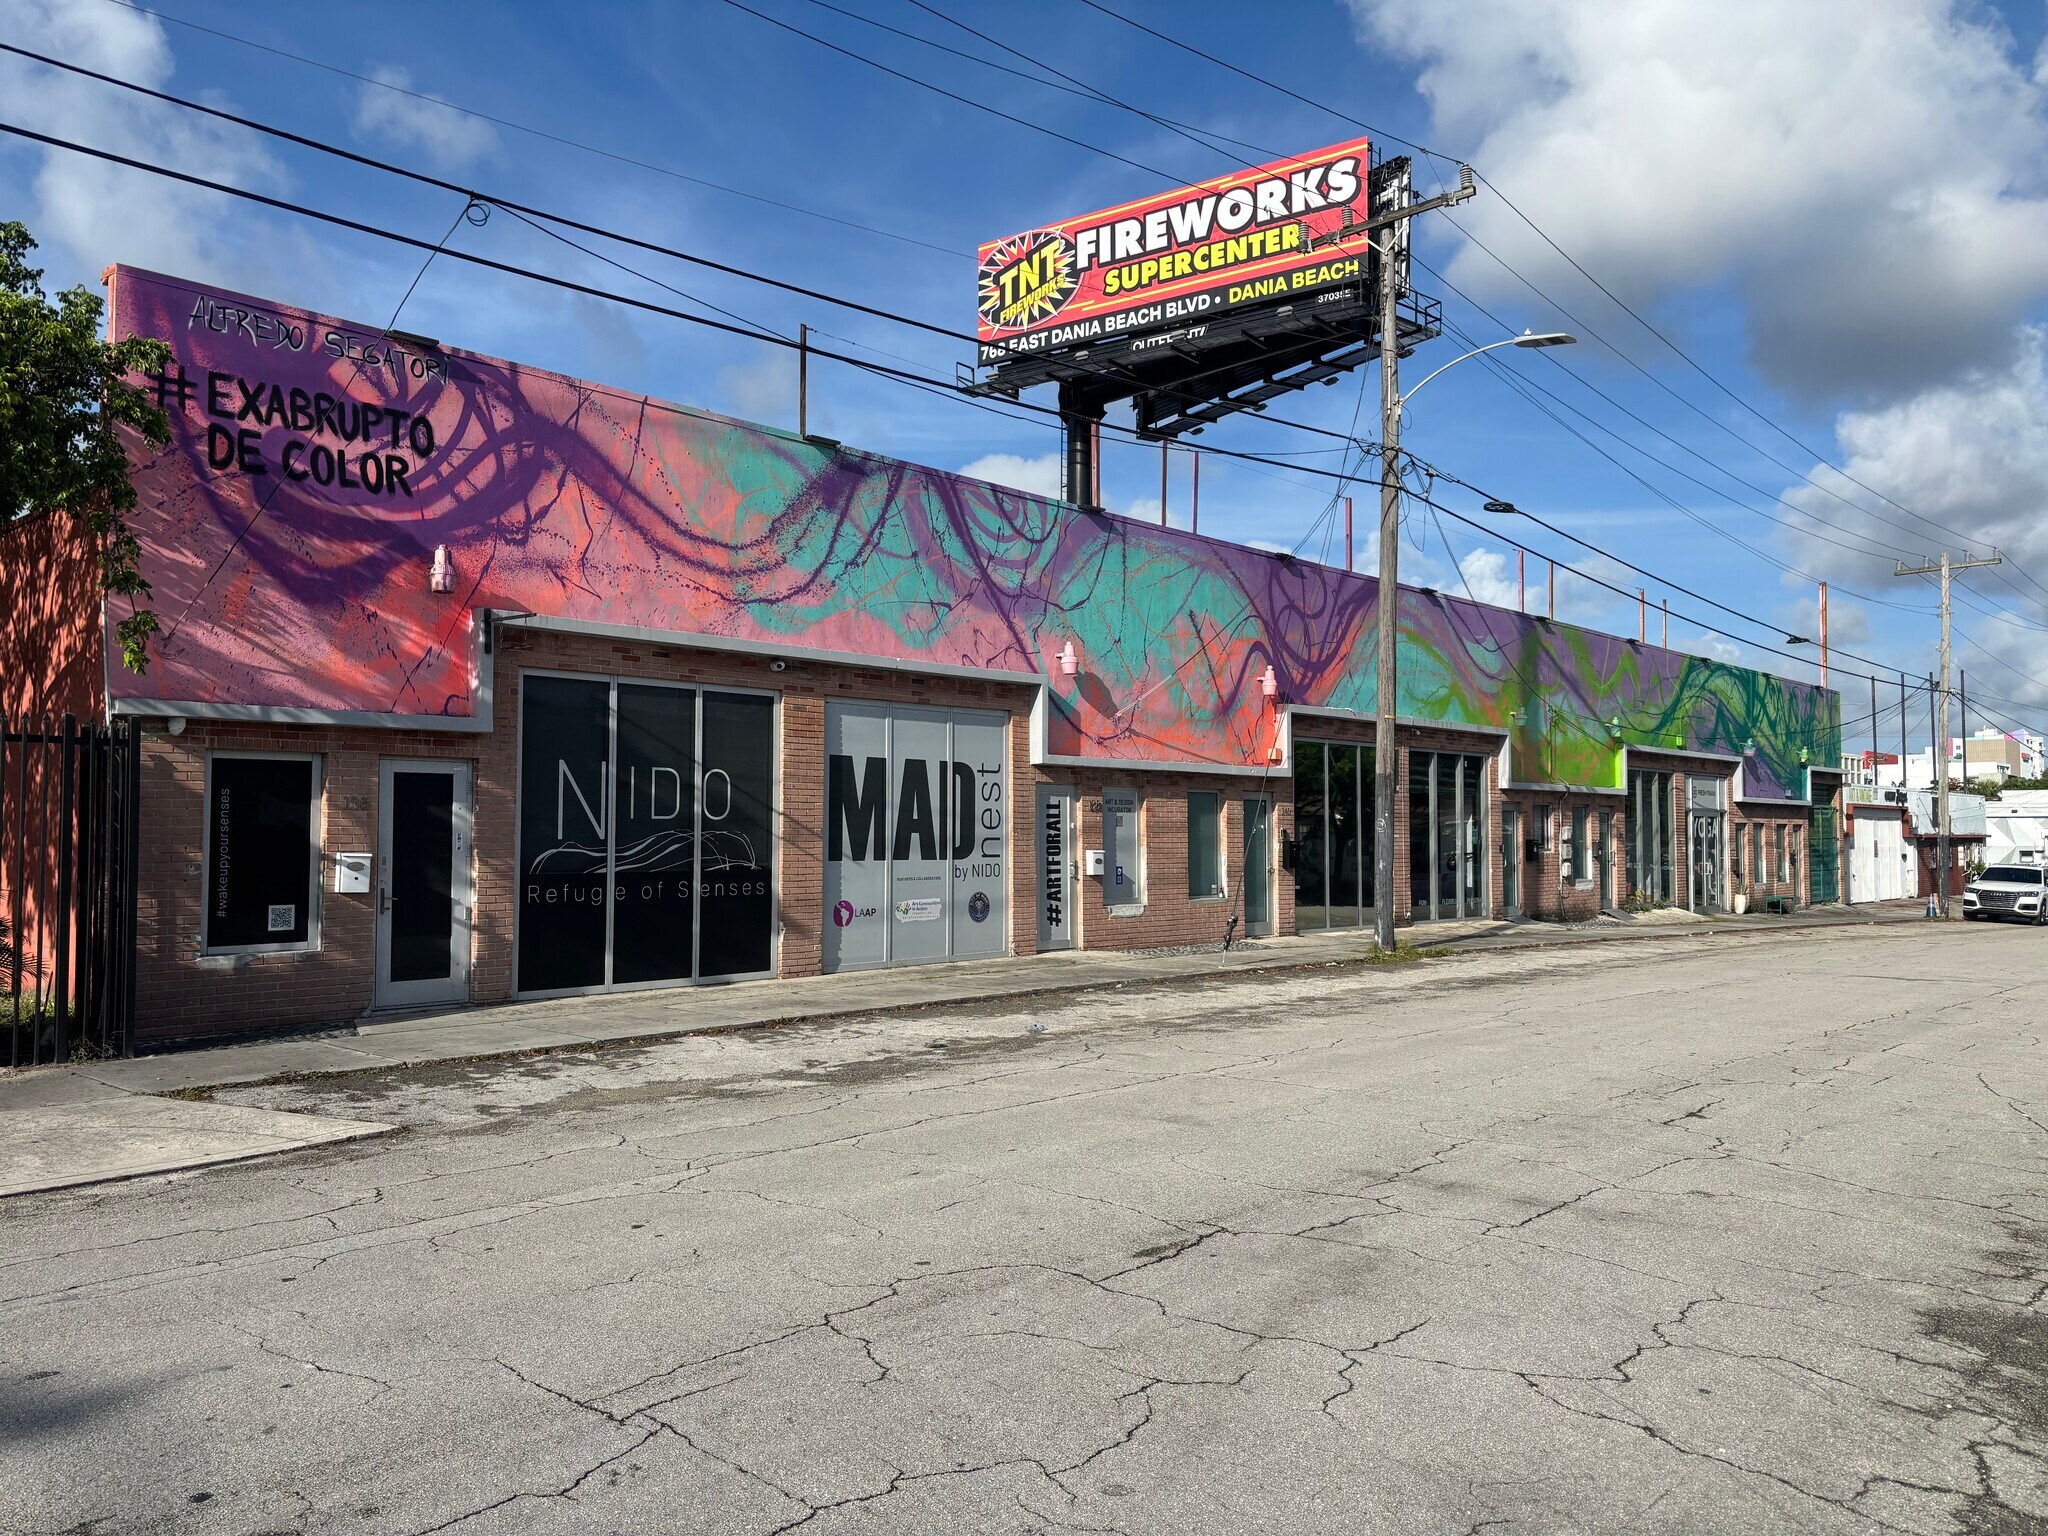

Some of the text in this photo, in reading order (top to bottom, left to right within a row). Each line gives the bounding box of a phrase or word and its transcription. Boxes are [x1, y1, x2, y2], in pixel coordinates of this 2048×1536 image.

[1076, 158, 1360, 269] FIREWORKS
[1000, 239, 1060, 308] TNT
[1104, 224, 1301, 295] SUPERCENTER
[188, 295, 305, 351] ALFREDO
[1000, 273, 1065, 324] FIREWORKS
[1009, 331, 1048, 354] EAST
[1051, 319, 1101, 345] DANIA
[1105, 307, 1162, 333] BEACH
[1166, 294, 1210, 318] BLVD
[1229, 276, 1288, 304] DANIA
[1292, 258, 1359, 290] BEACH
[208, 422, 414, 498] DE COLOR
[557, 758, 731, 840] NIDO
[828, 754, 976, 862] MAD
[976, 762, 1001, 858] nest
[1107, 806, 1132, 814] INCUBATOR
[1693, 817, 1718, 839] YOGA
[216, 787, 231, 918] #wakeupyoursenses
[954, 862, 1001, 882] by NIDO
[1046, 800, 1062, 927] #ARTFORALL
[527, 880, 766, 906] Refuge of Senses
[854, 907, 877, 918] LAAP
